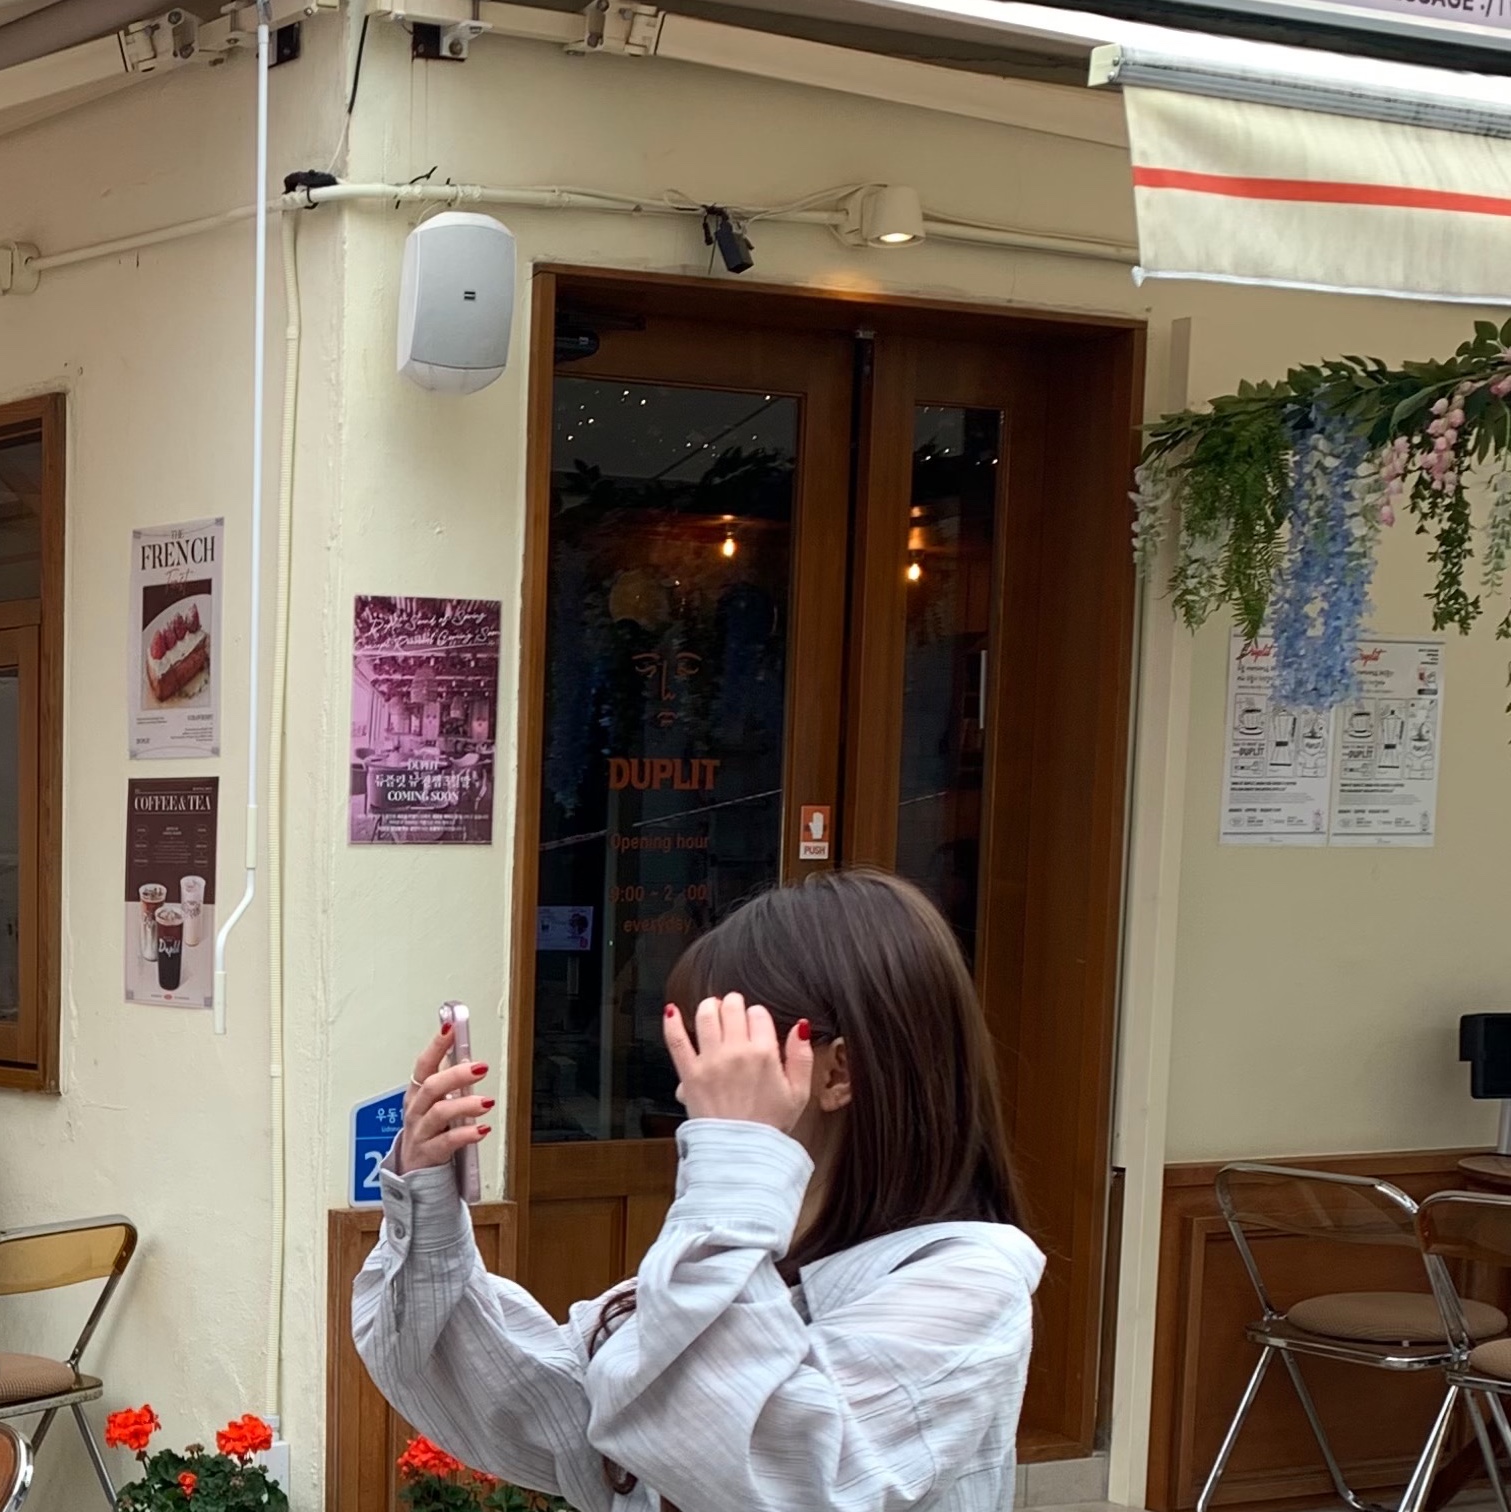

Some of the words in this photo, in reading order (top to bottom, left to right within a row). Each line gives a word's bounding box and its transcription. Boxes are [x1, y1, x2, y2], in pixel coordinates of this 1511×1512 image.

[141, 535, 215, 570] FRENCH
[608, 758, 720, 791] DUPLIT
[387, 790, 429, 802] COMING
[430, 790, 459, 802] SOON
[609, 834, 671, 853] Opening
[676, 834, 709, 849] hour
[804, 845, 826, 855] PUSH
[663, 884, 708, 901] 2:00
[622, 916, 692, 935] everyday
[375, 1107, 404, 1125] 우동1
[363, 1150, 384, 1188] 2
